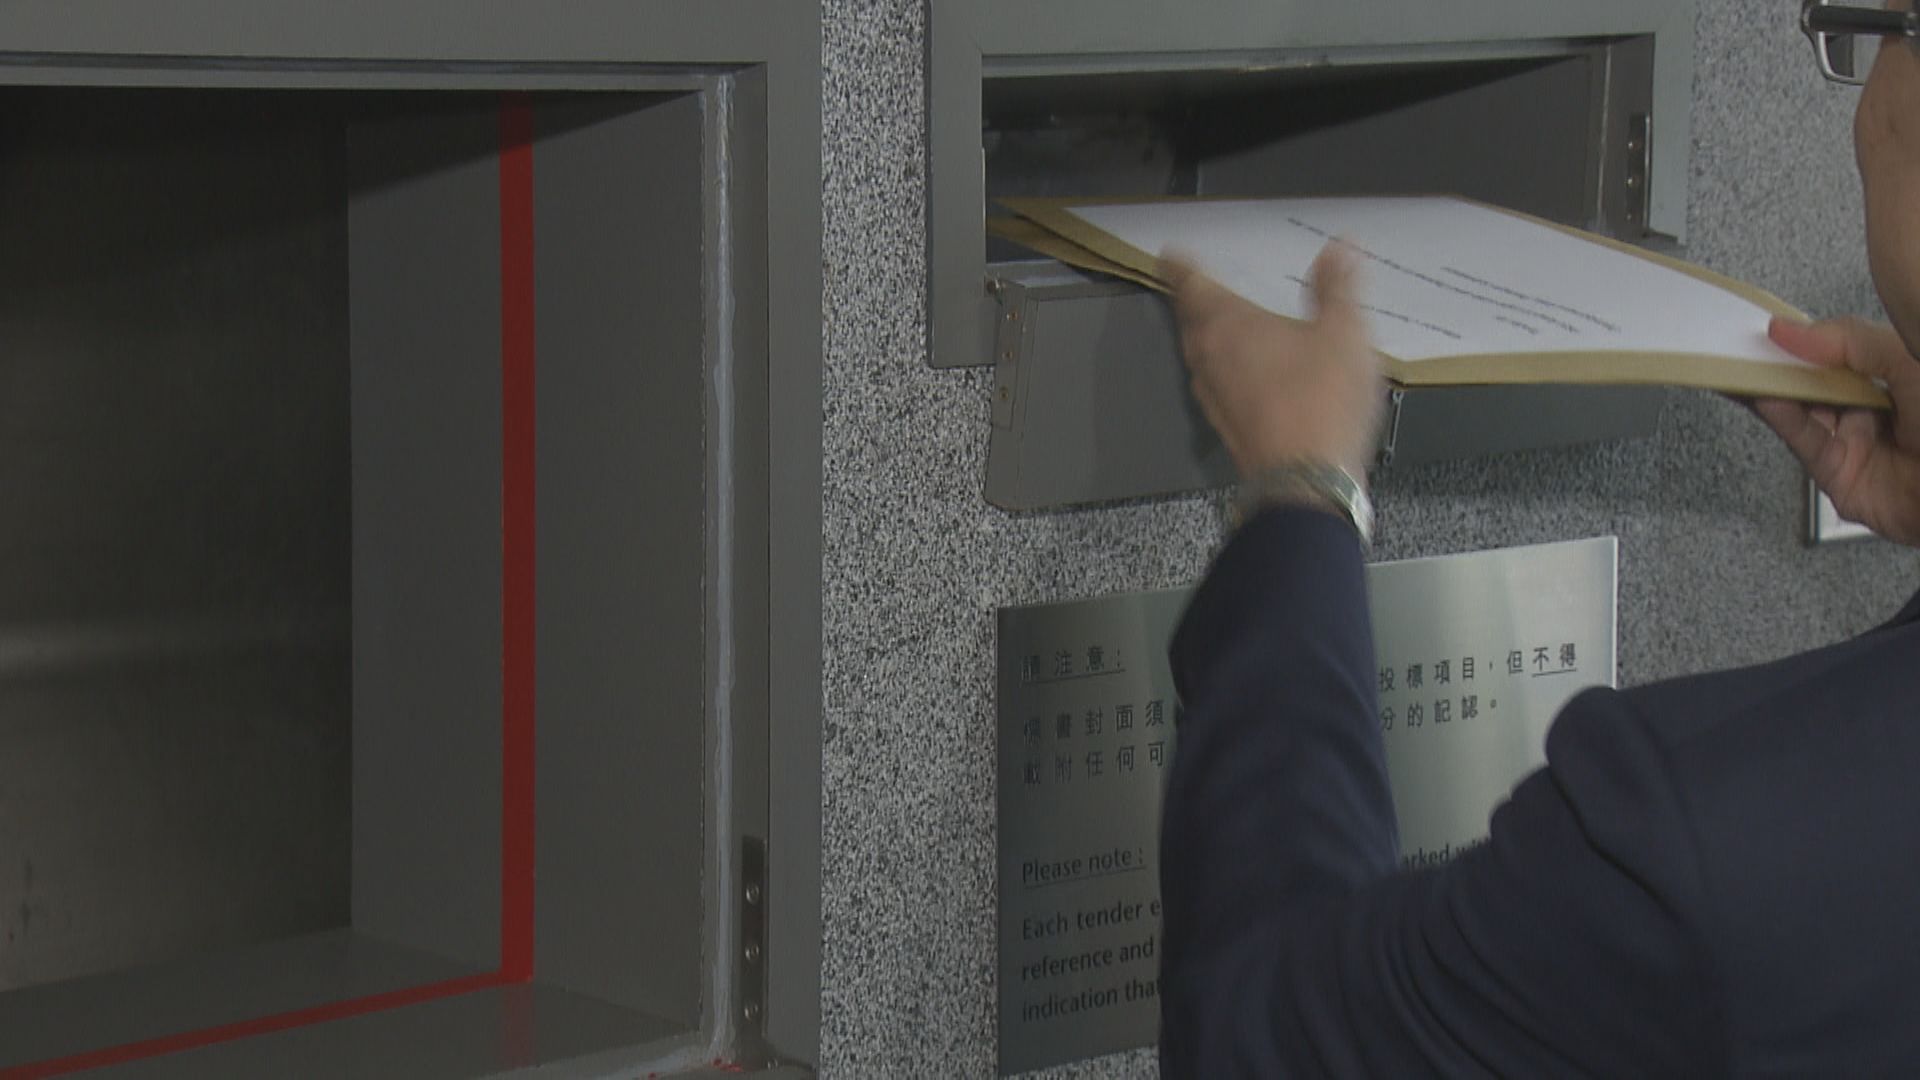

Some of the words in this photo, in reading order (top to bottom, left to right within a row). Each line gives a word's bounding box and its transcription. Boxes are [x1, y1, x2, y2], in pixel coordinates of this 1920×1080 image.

[1022, 857, 1082, 884] Please
[1022, 912, 1068, 941] Each
[1077, 901, 1143, 931] tender
[1402, 843, 1450, 870] arked
[1021, 950, 1113, 982] reference
[1119, 936, 1154, 964] and
[1022, 987, 1118, 1023] indication
